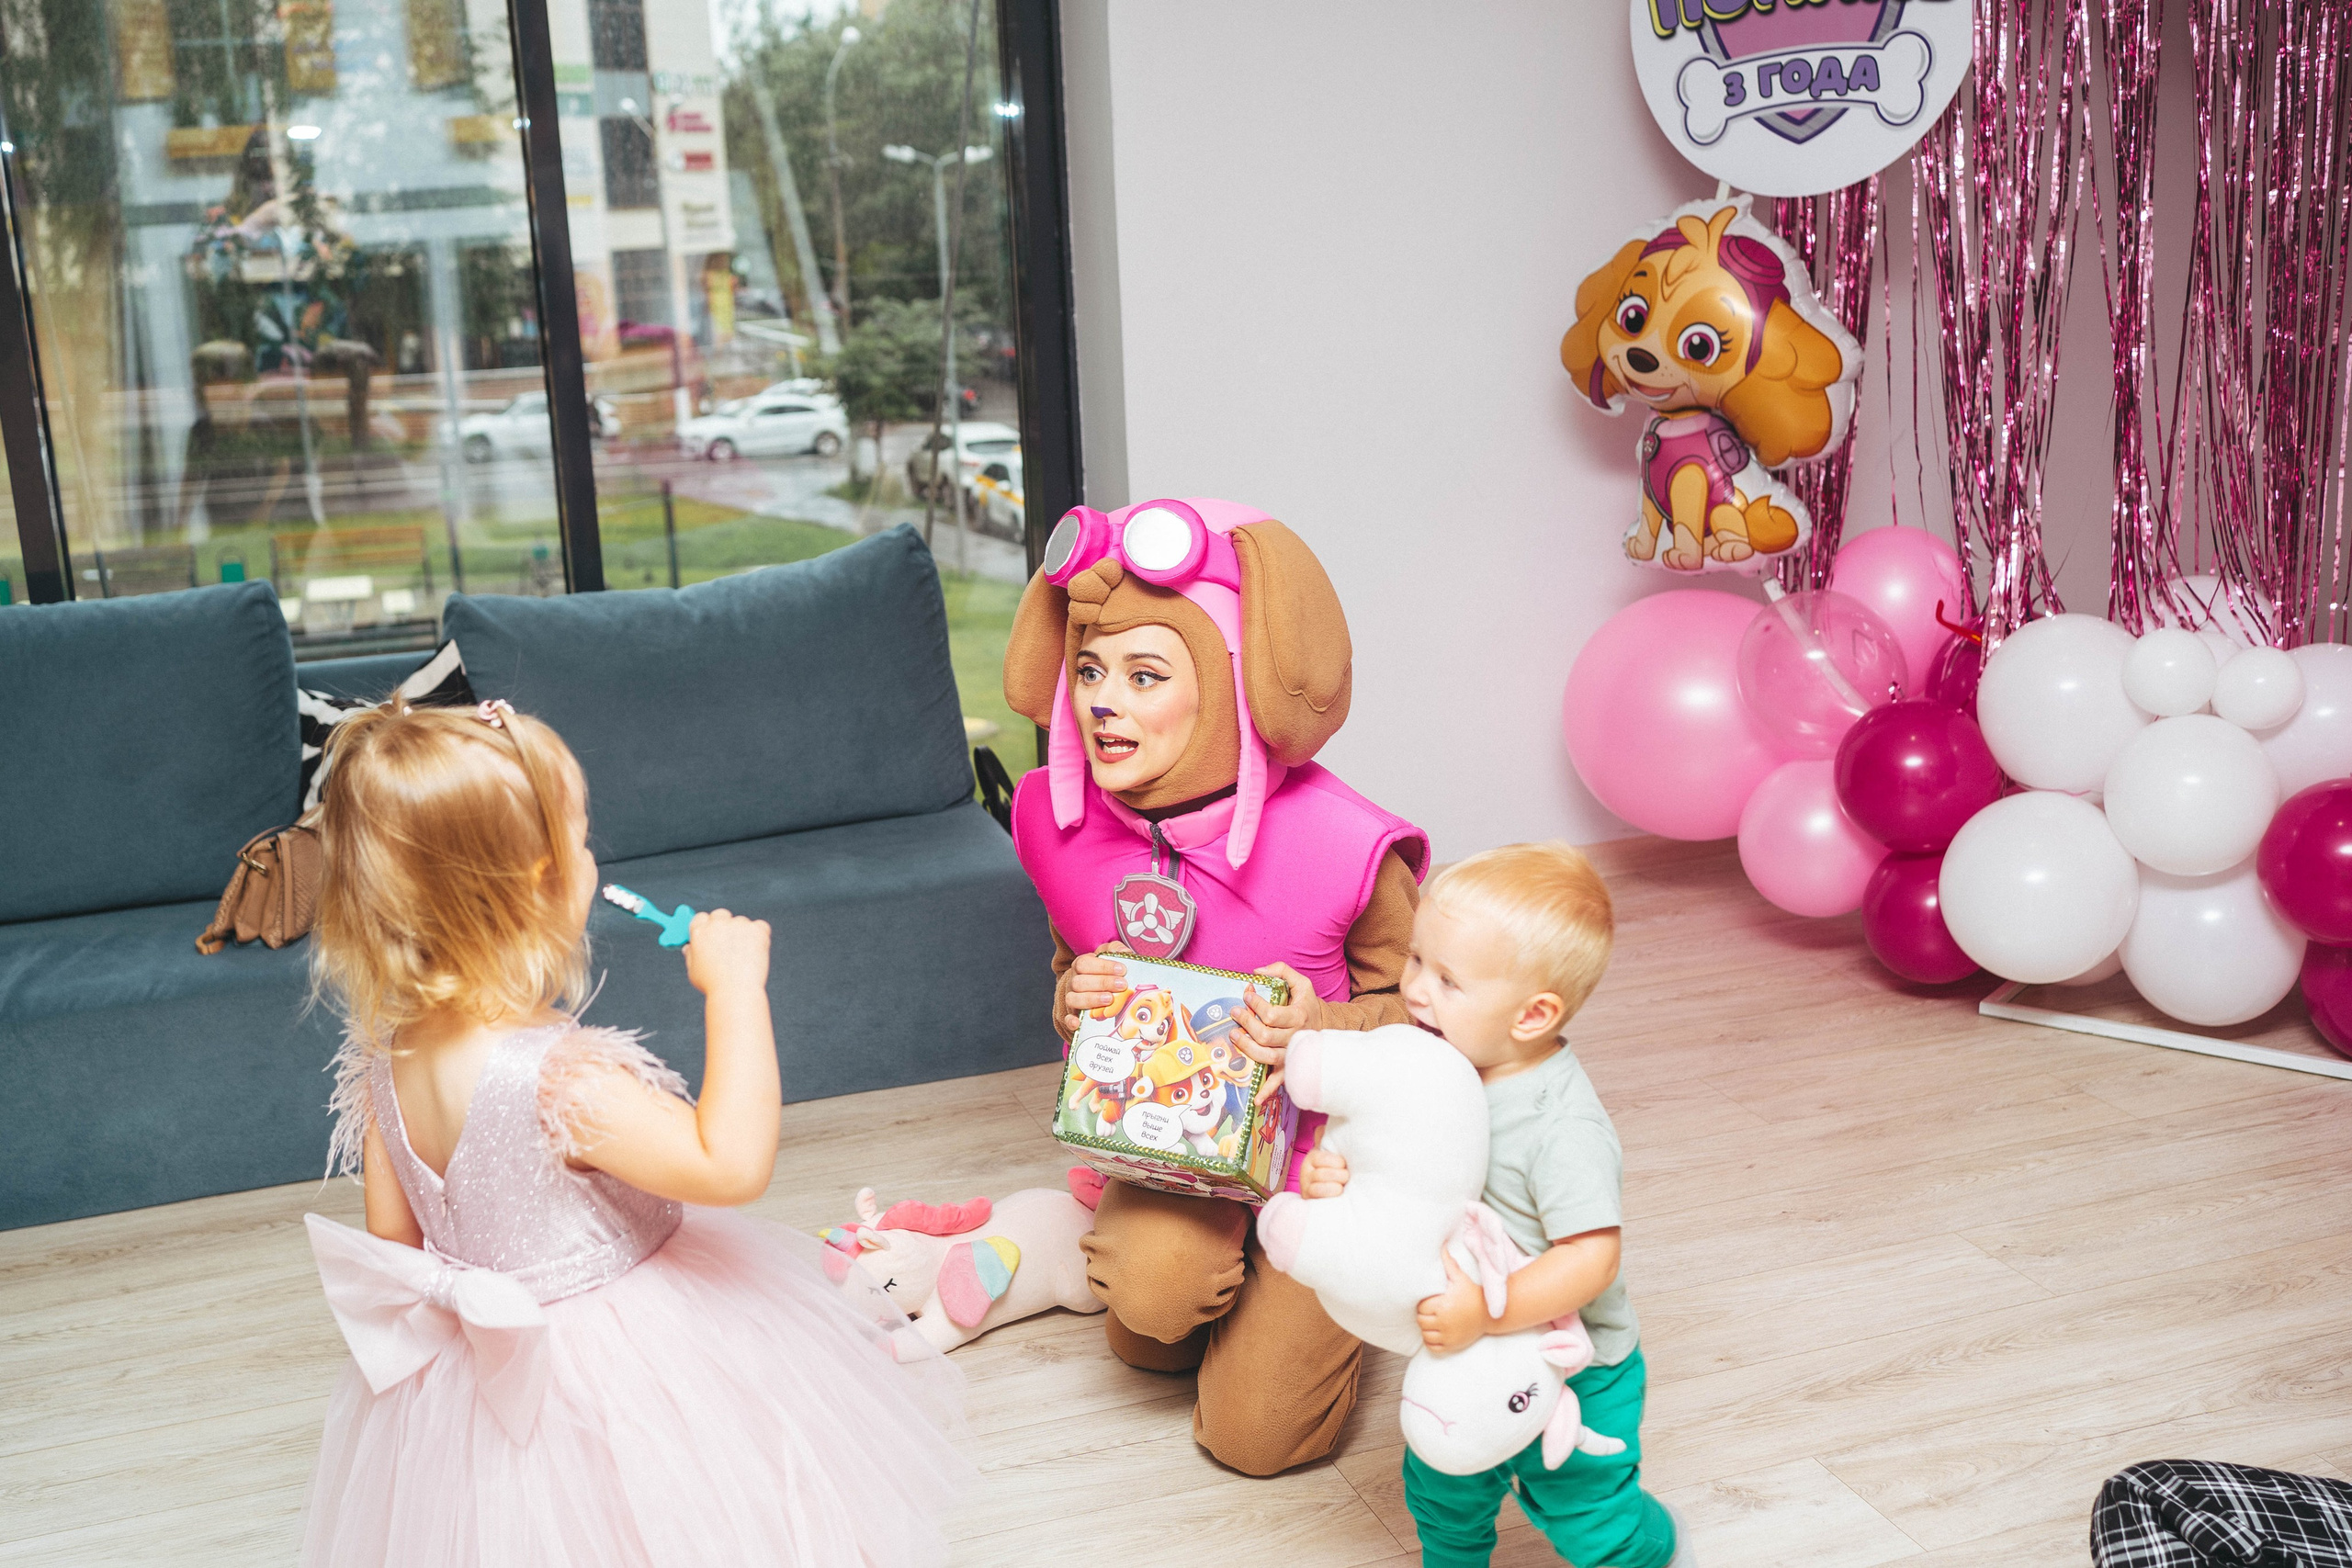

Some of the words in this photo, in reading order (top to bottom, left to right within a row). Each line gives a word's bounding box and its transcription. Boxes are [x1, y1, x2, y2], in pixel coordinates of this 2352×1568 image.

[1723, 72, 1746, 107] 3
[1757, 55, 1880, 98] ГОДА
[1094, 1043, 1121, 1055] поймай
[1096, 1053, 1114, 1063] всех
[1090, 1062, 1114, 1074] друзей
[1142, 1111, 1170, 1124] прыгни
[1142, 1121, 1163, 1133] выше
[1141, 1131, 1159, 1142] всех
